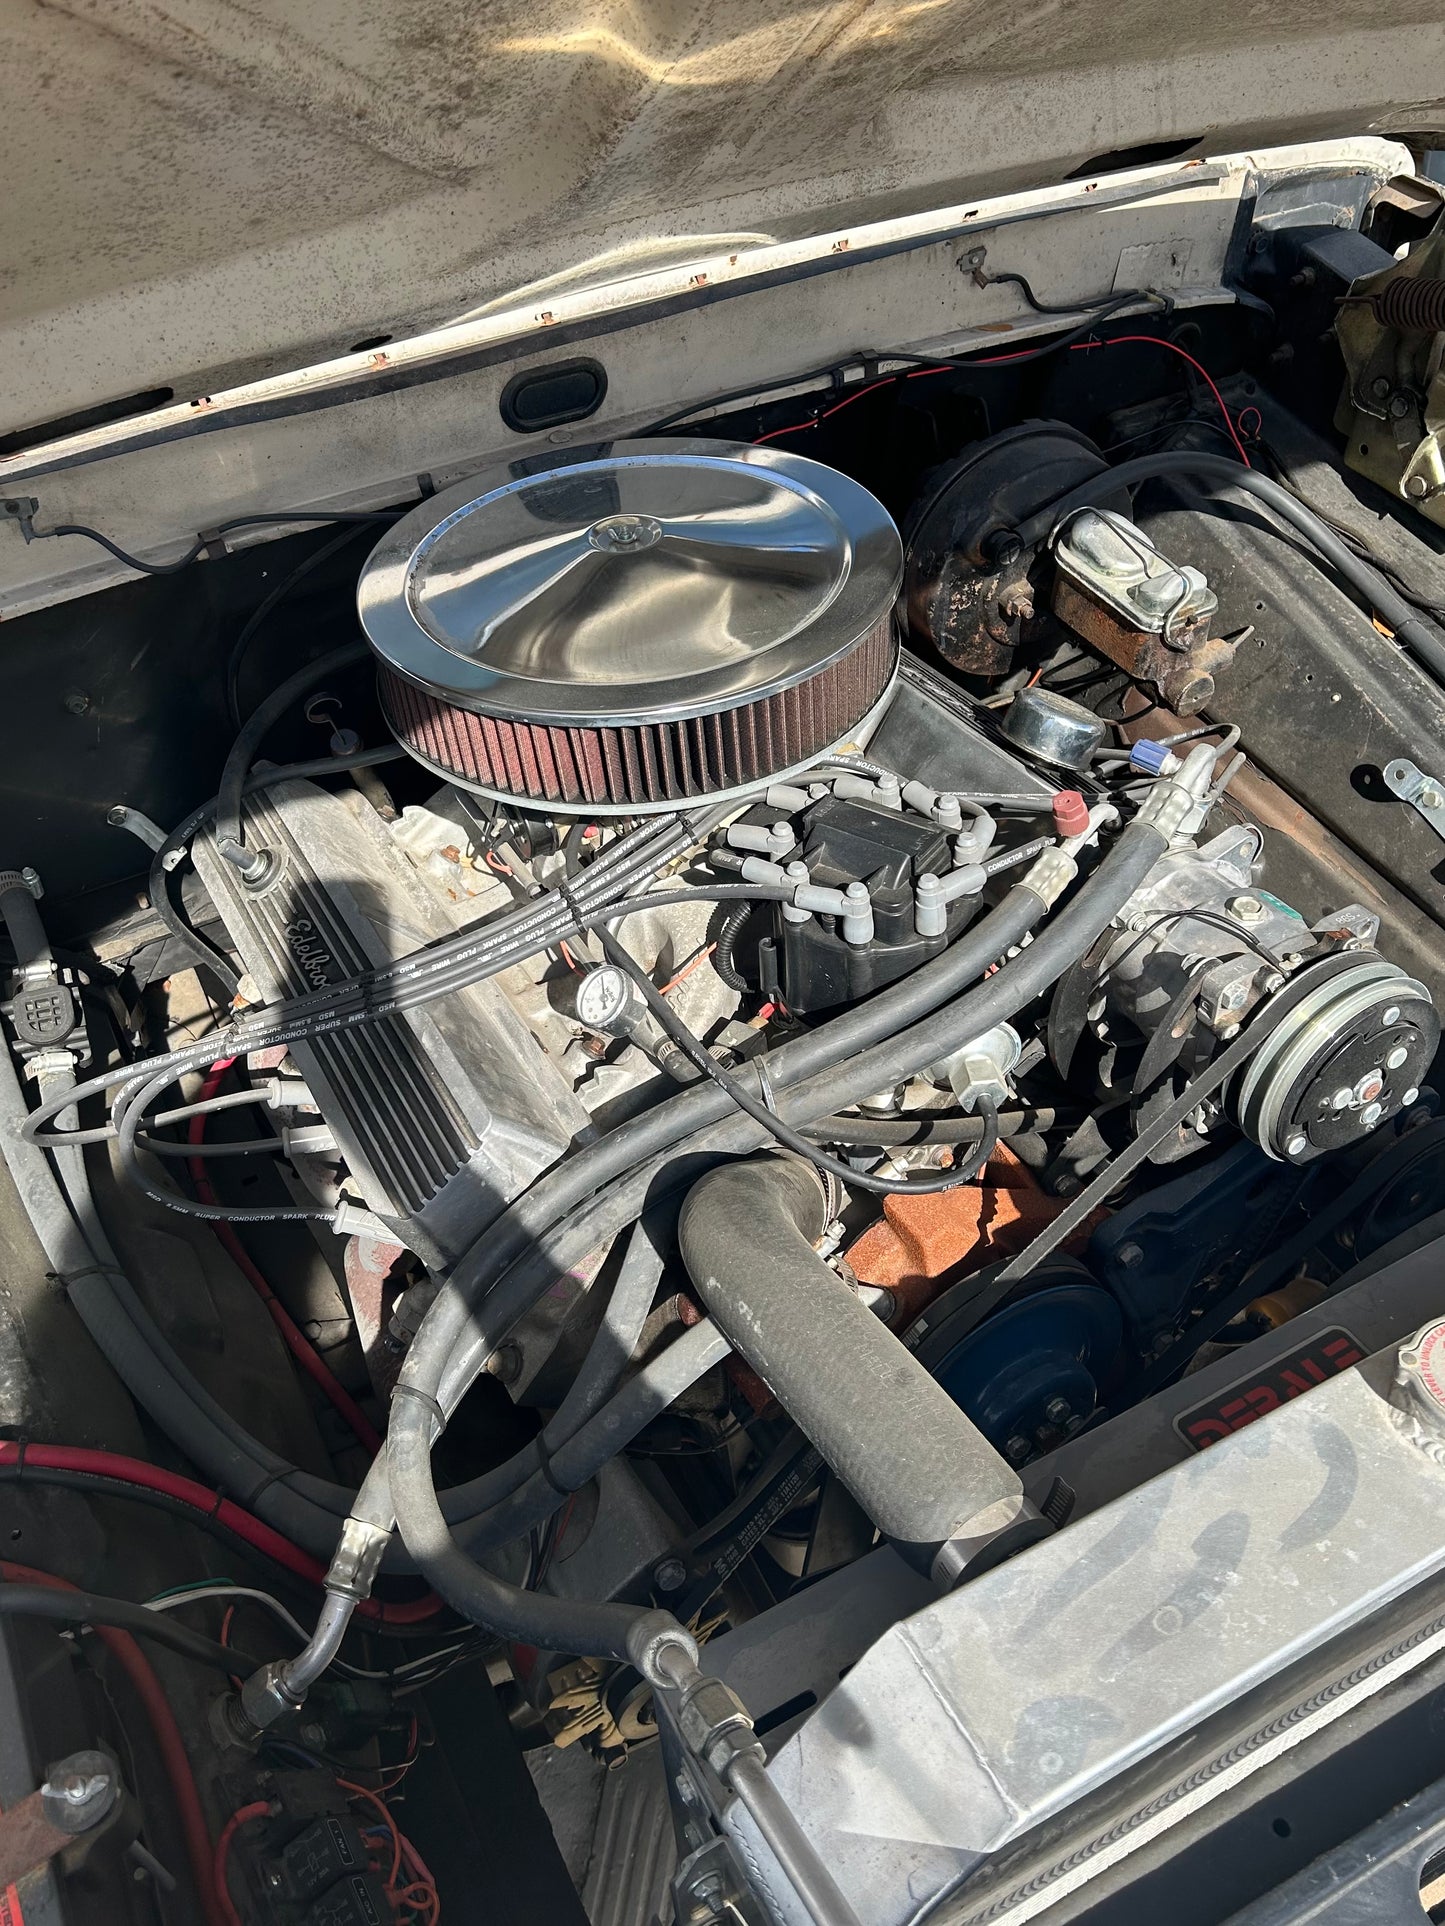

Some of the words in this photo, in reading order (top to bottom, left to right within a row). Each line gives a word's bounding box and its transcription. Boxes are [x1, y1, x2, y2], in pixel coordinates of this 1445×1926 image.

[640, 812, 678, 839] ONDUCTOR
[613, 838, 635, 859] SPARK
[591, 858, 609, 876] PLUG
[616, 859, 632, 874] MSD
[987, 851, 1024, 873] CONDUCTOR
[628, 866, 652, 885] SUPER
[568, 876, 587, 892] WIRE
[580, 884, 624, 914] CONDUCTOR
[513, 907, 557, 935] CONDUCTOR
[483, 933, 508, 951] SPARK
[524, 927, 546, 942] PLUG
[285, 919, 332, 990] Edelbro
[457, 946, 478, 961] PLUG
[500, 939, 520, 955] WIRE
[399, 963, 416, 974] MSD
[431, 957, 452, 972] WIRE
[378, 1001, 396, 1012] MSD
[318, 1010, 335, 1021] MSD
[248, 1021, 265, 1033] MSD
[314, 1018, 342, 1033] SUPER
[258, 1028, 309, 1047] CONDUCTOR
[169, 1047, 196, 1061] SPARK
[225, 1041, 252, 1058] SPARK
[141, 1057, 163, 1070] PLUG
[199, 1052, 220, 1065] PLUG
[113, 1066, 135, 1079] WIRE
[175, 1061, 194, 1076] WIRE
[194, 1211, 221, 1221] SUPER
[227, 1214, 276, 1222] CONDUCTOR
[282, 1212, 308, 1220] SPARK
[314, 1213, 337, 1222] PLUG
[1421, 1361, 1430, 1371] TO
